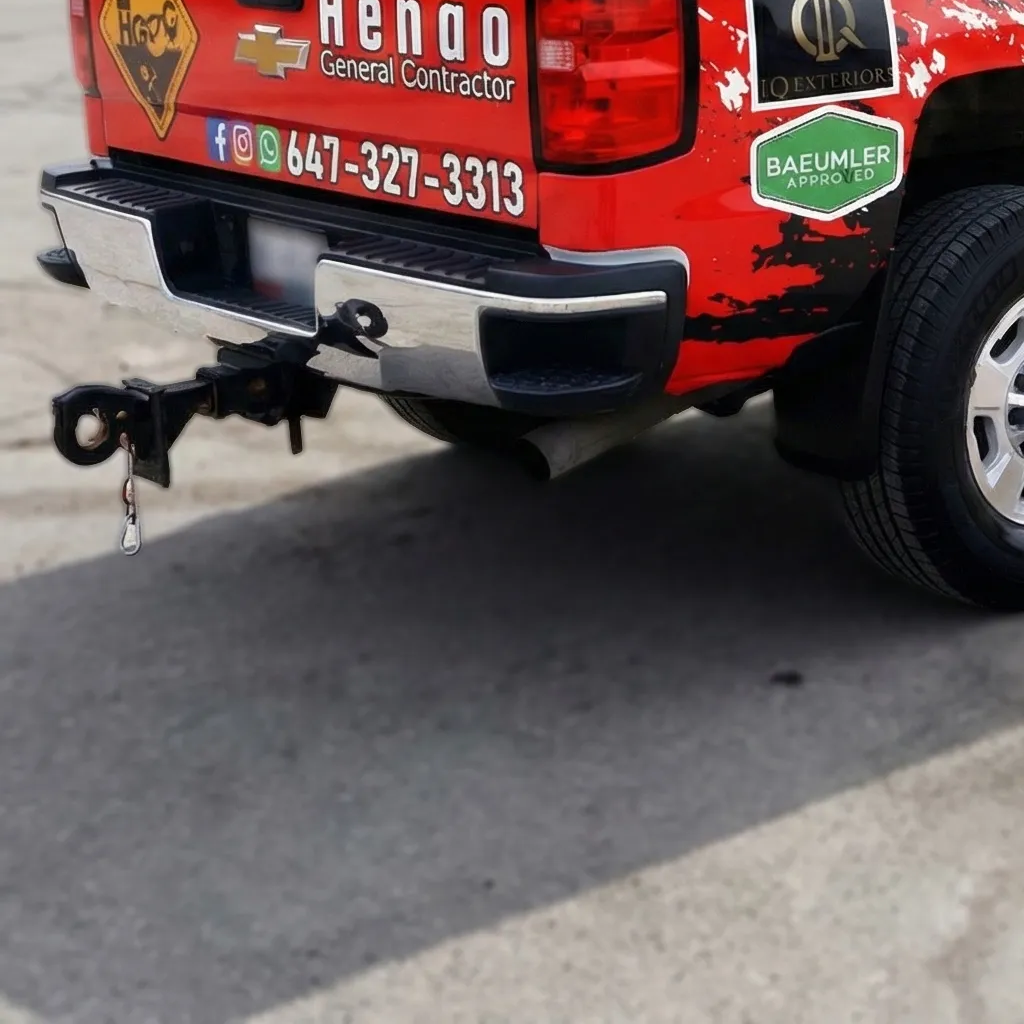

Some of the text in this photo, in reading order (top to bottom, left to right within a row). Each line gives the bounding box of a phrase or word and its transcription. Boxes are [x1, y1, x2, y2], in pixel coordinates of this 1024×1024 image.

[320, 50, 516, 101] General Contractor
[761, 67, 894, 99] IQ EXTERIORS
[286, 130, 526, 217] 647-327-3313
[766, 144, 891, 178] BAEUMLER
[787, 167, 875, 190] APPROVED
